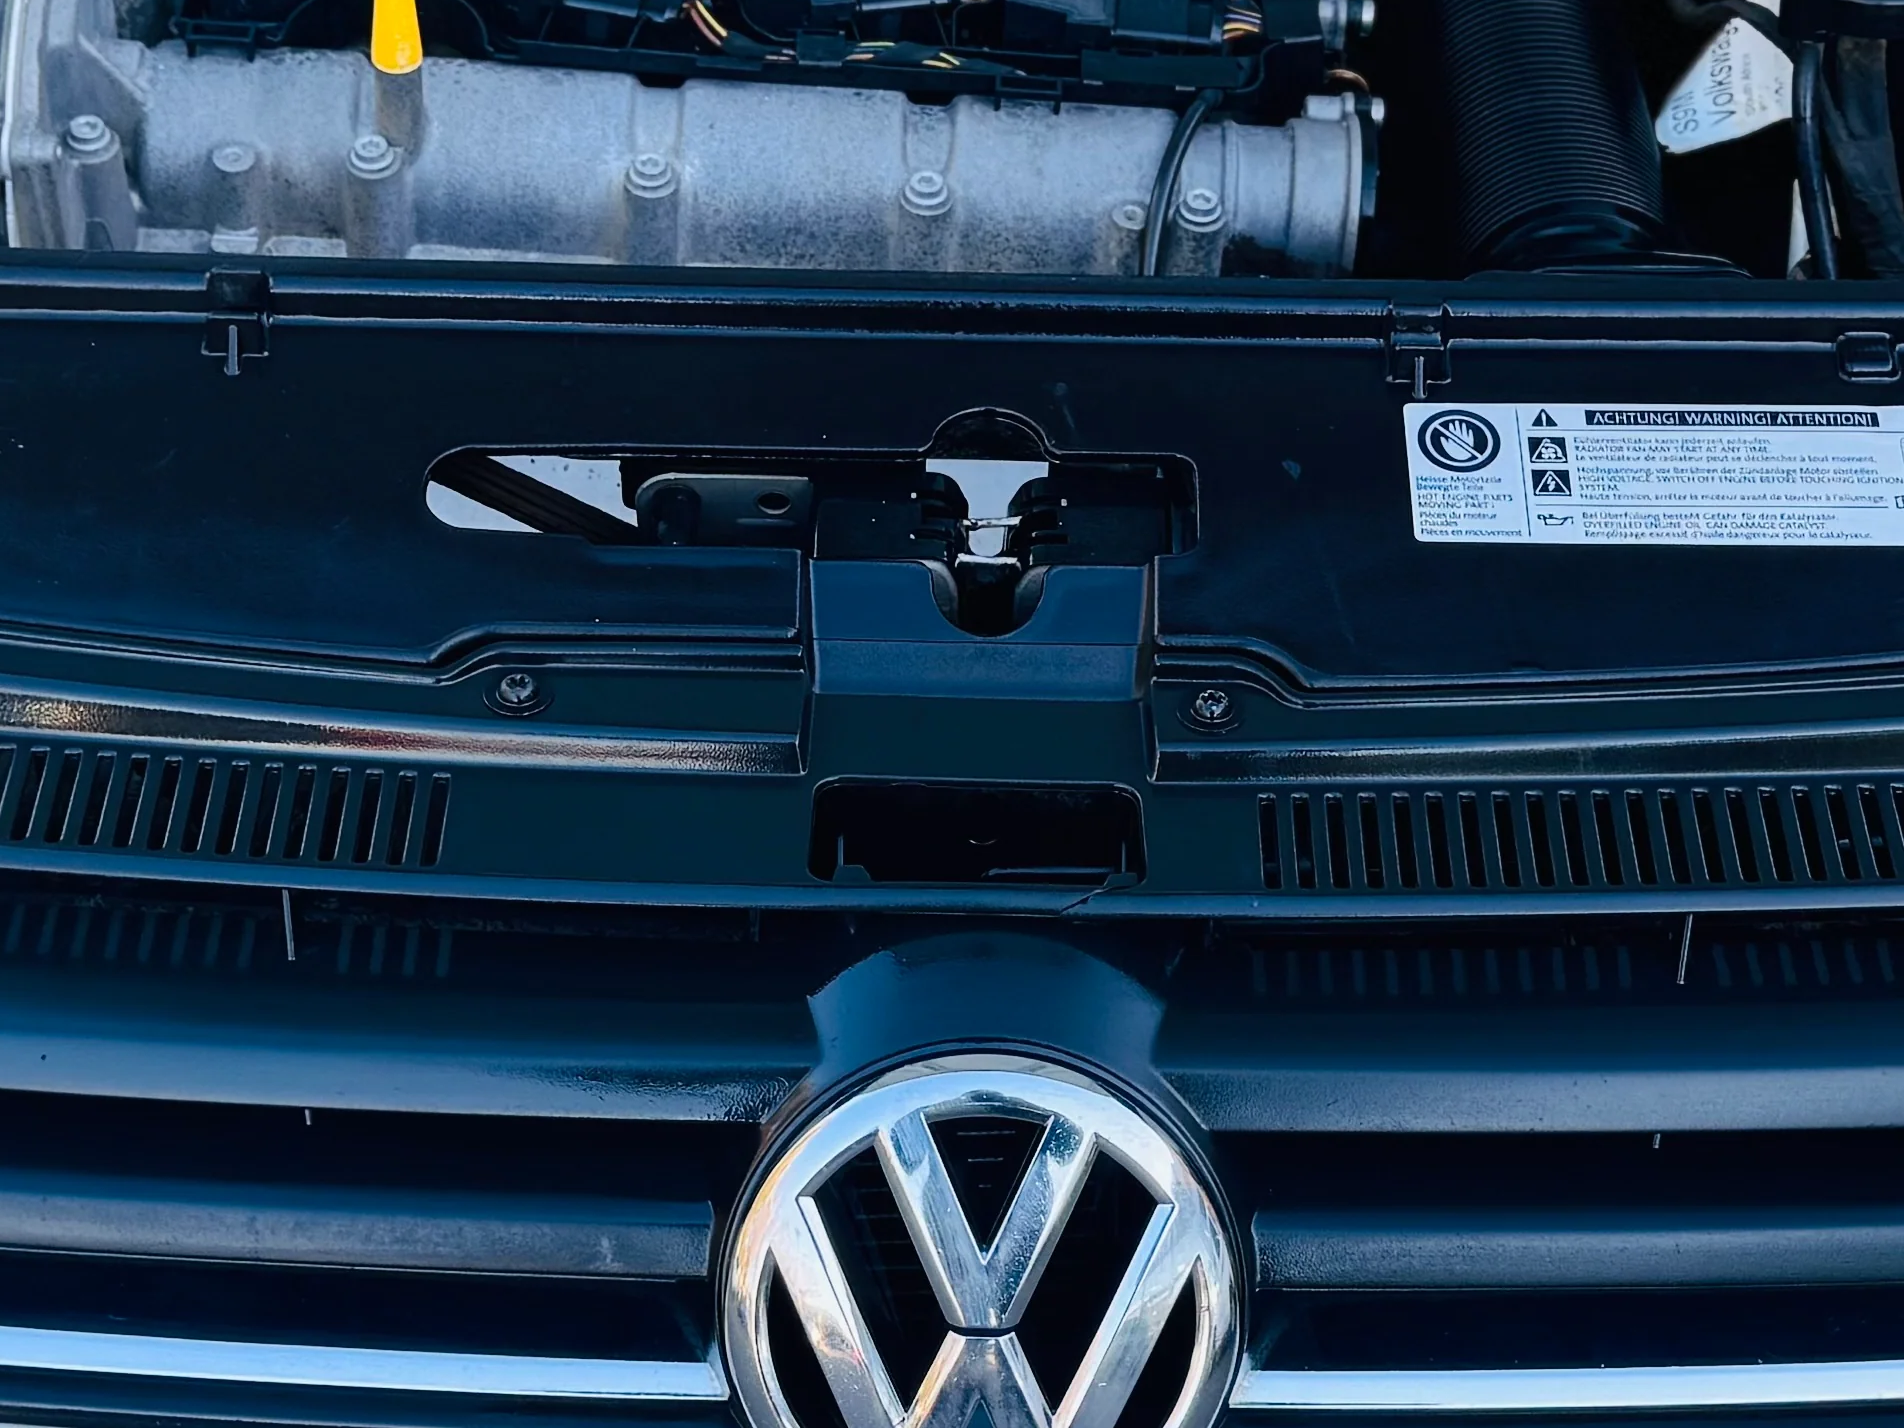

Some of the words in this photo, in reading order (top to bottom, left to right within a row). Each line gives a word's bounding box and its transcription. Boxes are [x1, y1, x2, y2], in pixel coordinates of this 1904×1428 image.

[1593, 412, 1679, 424] ACHTUNG!
[1684, 413, 1771, 425] WARNING!
[1777, 413, 1873, 425] ATTENTION!
